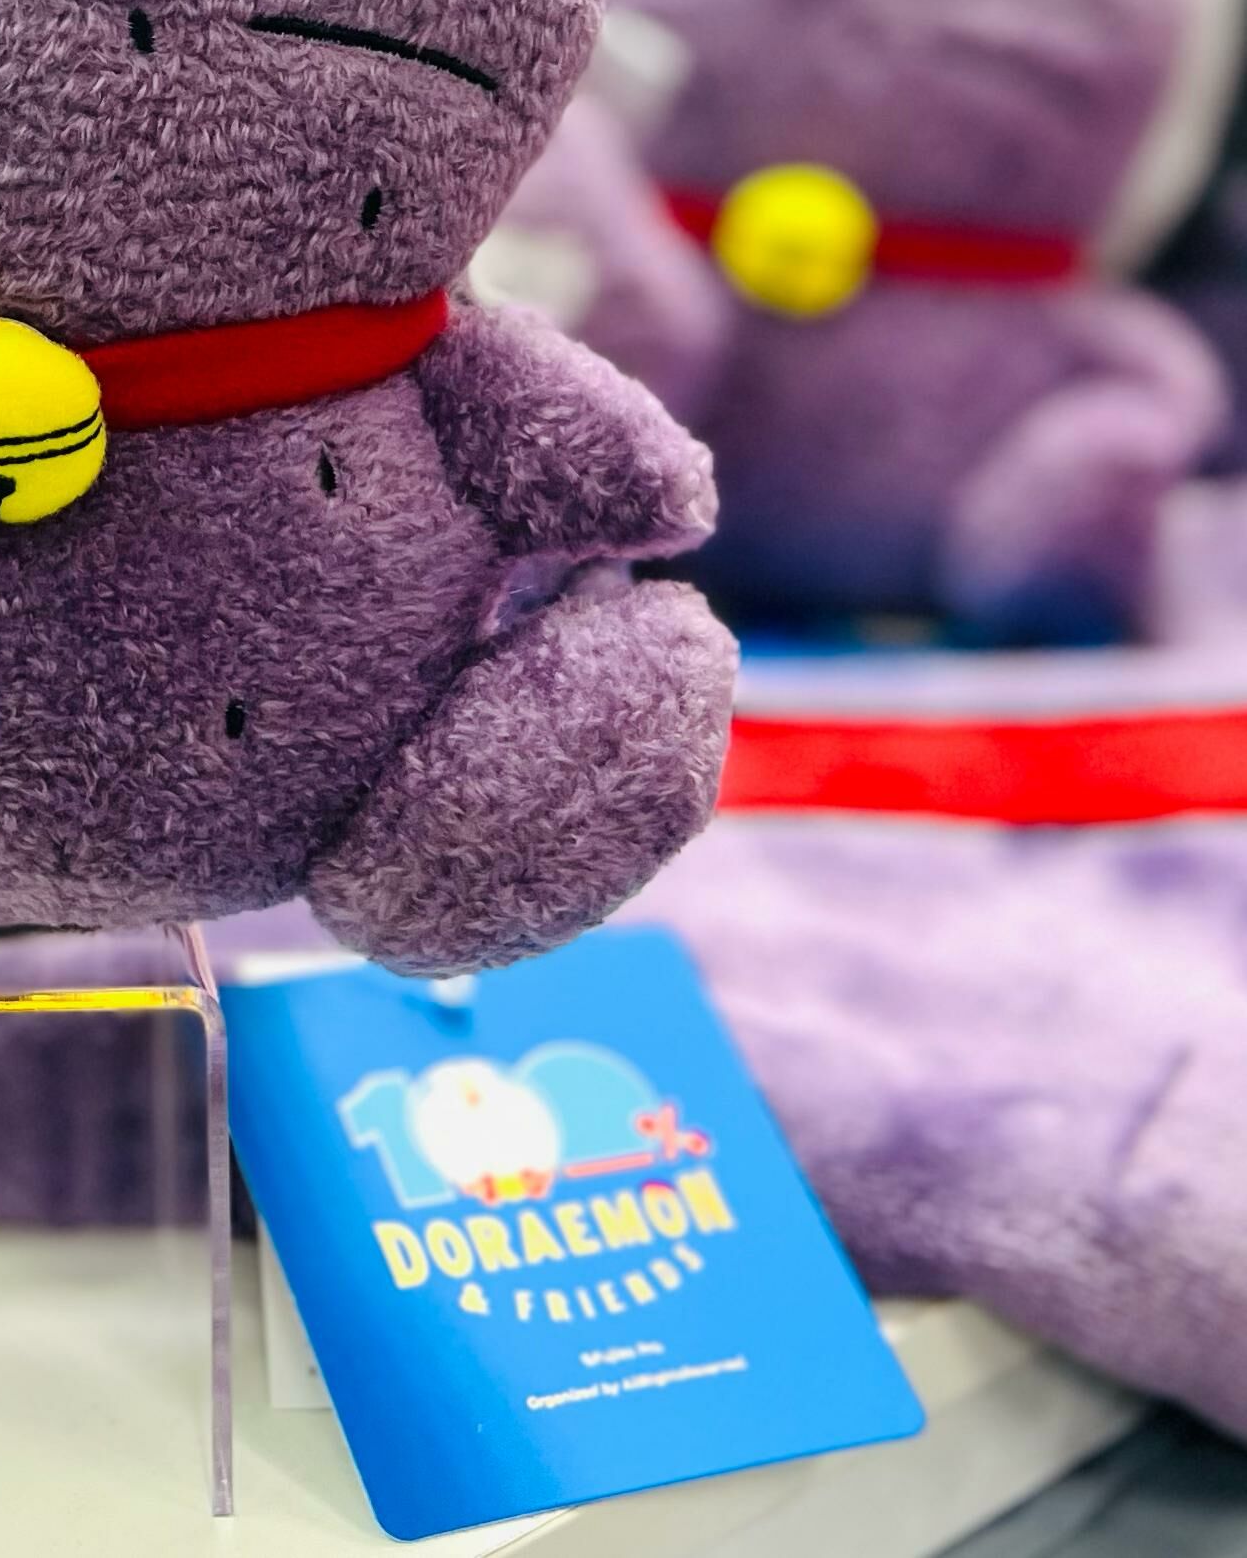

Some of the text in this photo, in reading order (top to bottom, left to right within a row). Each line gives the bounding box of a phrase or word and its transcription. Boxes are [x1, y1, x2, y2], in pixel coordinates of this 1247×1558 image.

[373, 1169, 733, 1289] DORAEMON
[459, 1244, 703, 1321] & FRIENDS
